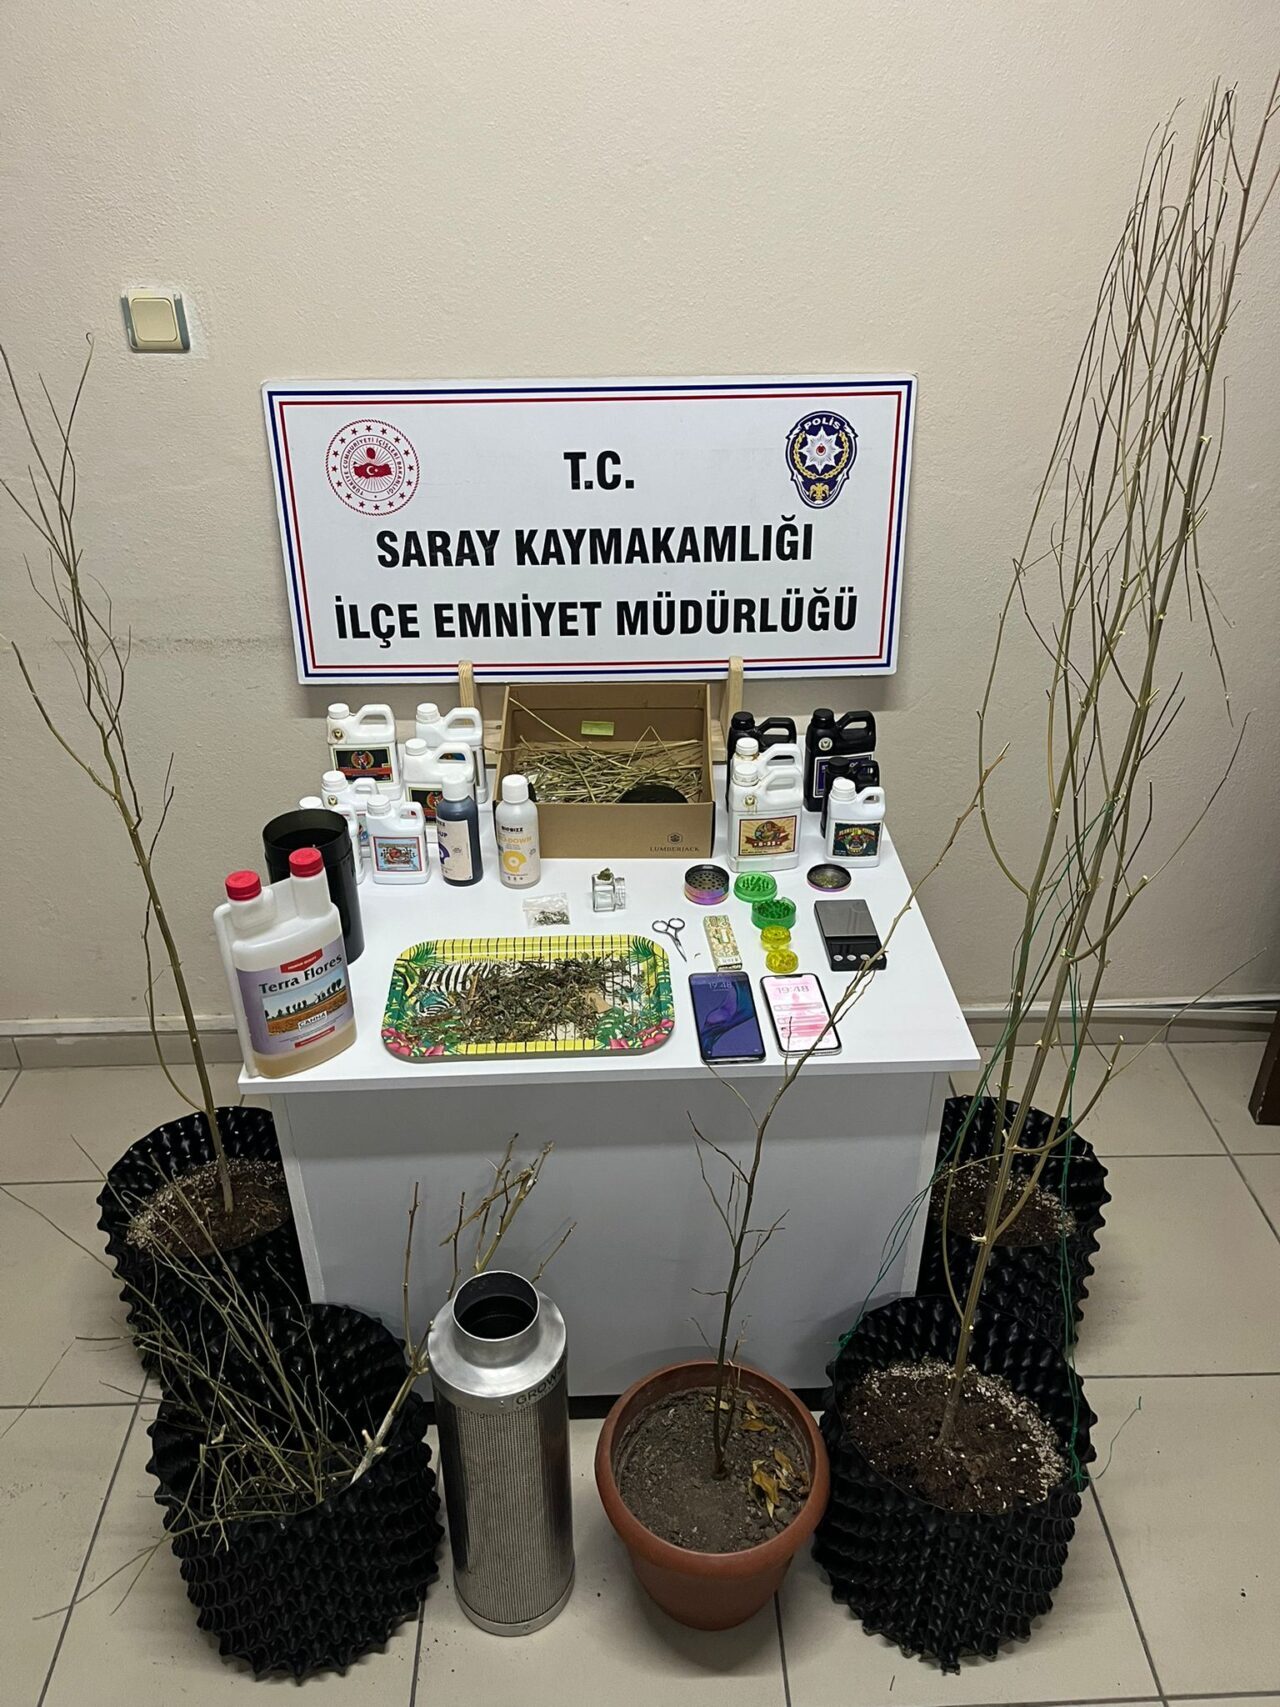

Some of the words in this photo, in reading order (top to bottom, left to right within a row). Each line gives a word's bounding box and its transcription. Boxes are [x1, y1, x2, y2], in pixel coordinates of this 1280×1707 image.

[803, 417, 841, 430] POLİS
[563, 450, 635, 491] T.C.
[376, 530, 501, 569] SARAY
[514, 514, 813, 567] KAYMAKAMLIĞI
[334, 595, 420, 649] İLÇE
[433, 593, 602, 638] EMNİYET
[616, 586, 858, 636] MÜDÜRLÜĞÜ
[259, 976, 300, 994] Terra
[303, 953, 343, 981] Flores
[777, 985, 810, 994] 19:48
